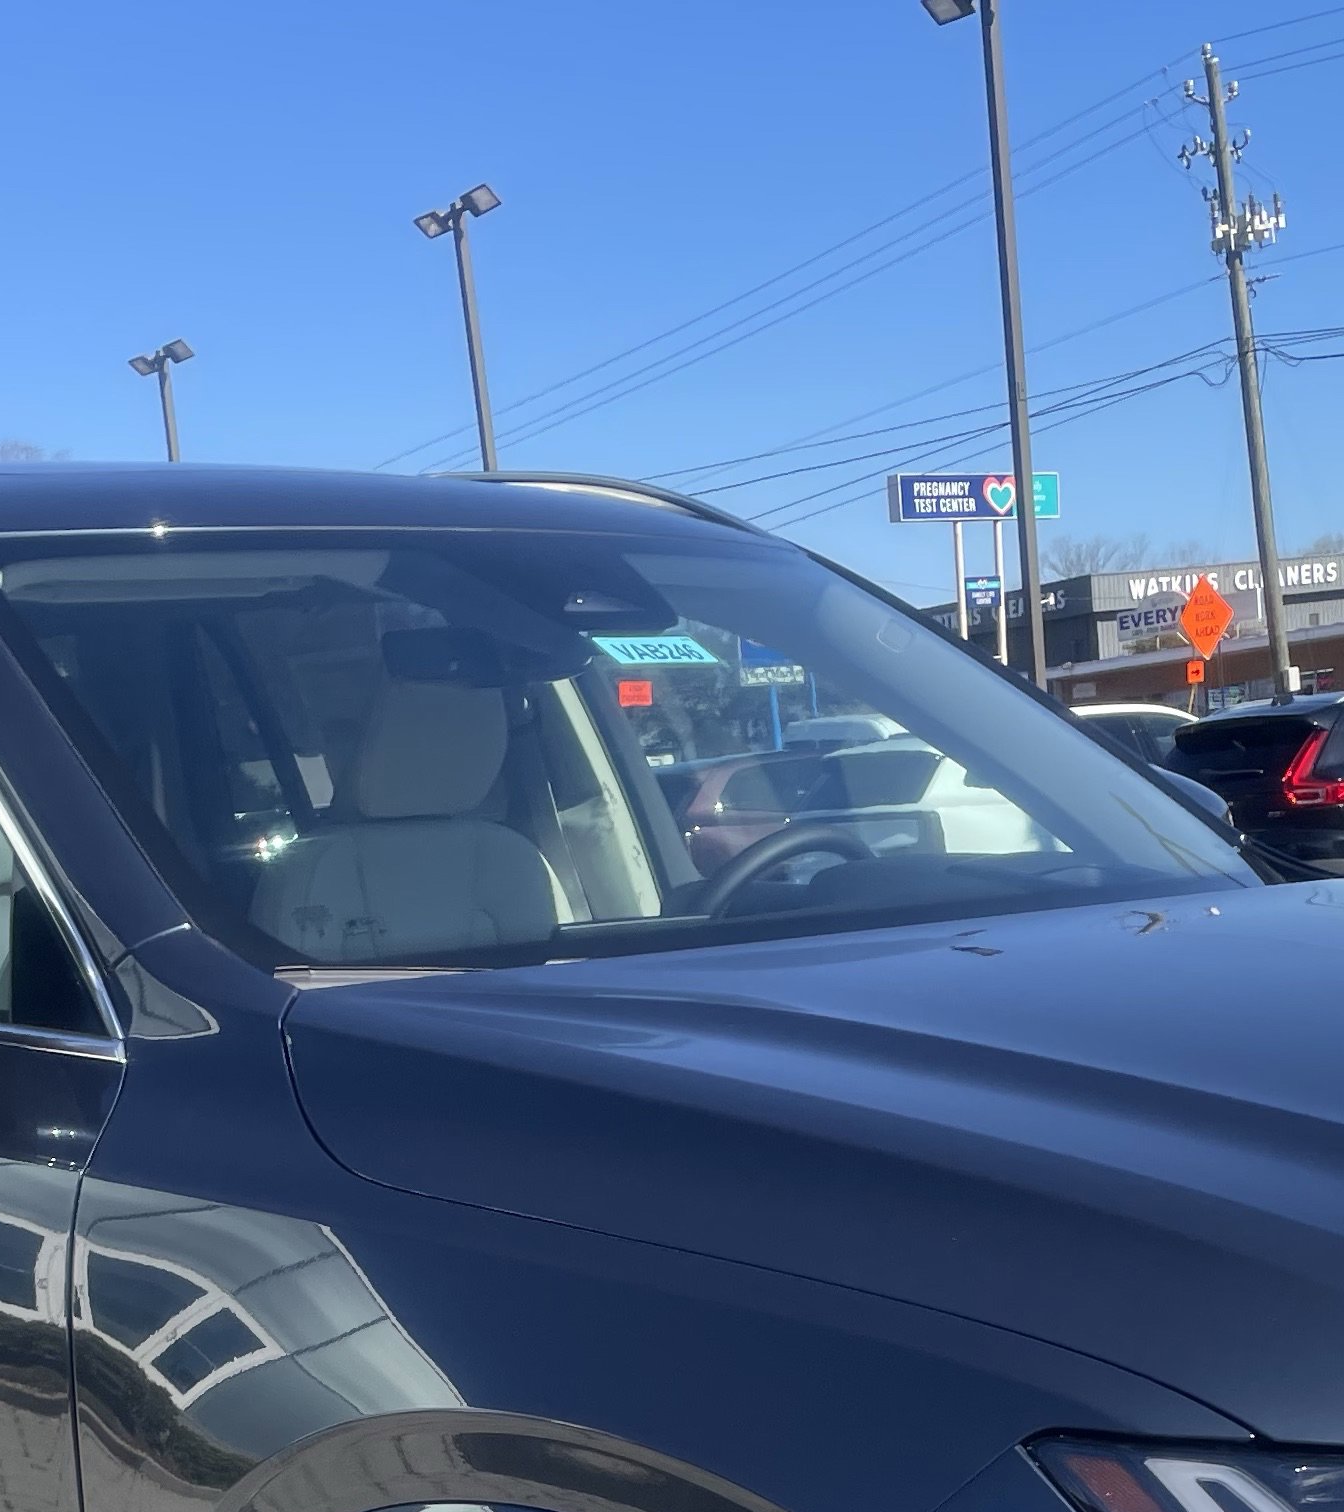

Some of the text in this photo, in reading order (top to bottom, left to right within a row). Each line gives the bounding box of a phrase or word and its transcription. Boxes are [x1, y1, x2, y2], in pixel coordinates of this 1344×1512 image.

[913, 481, 971, 496] PREGNANCY
[914, 497, 976, 513] TEST CENTER
[1235, 562, 1337, 590] CLNERS
[1119, 605, 1185, 630] EVERY
[610, 643, 704, 661] VAB246
